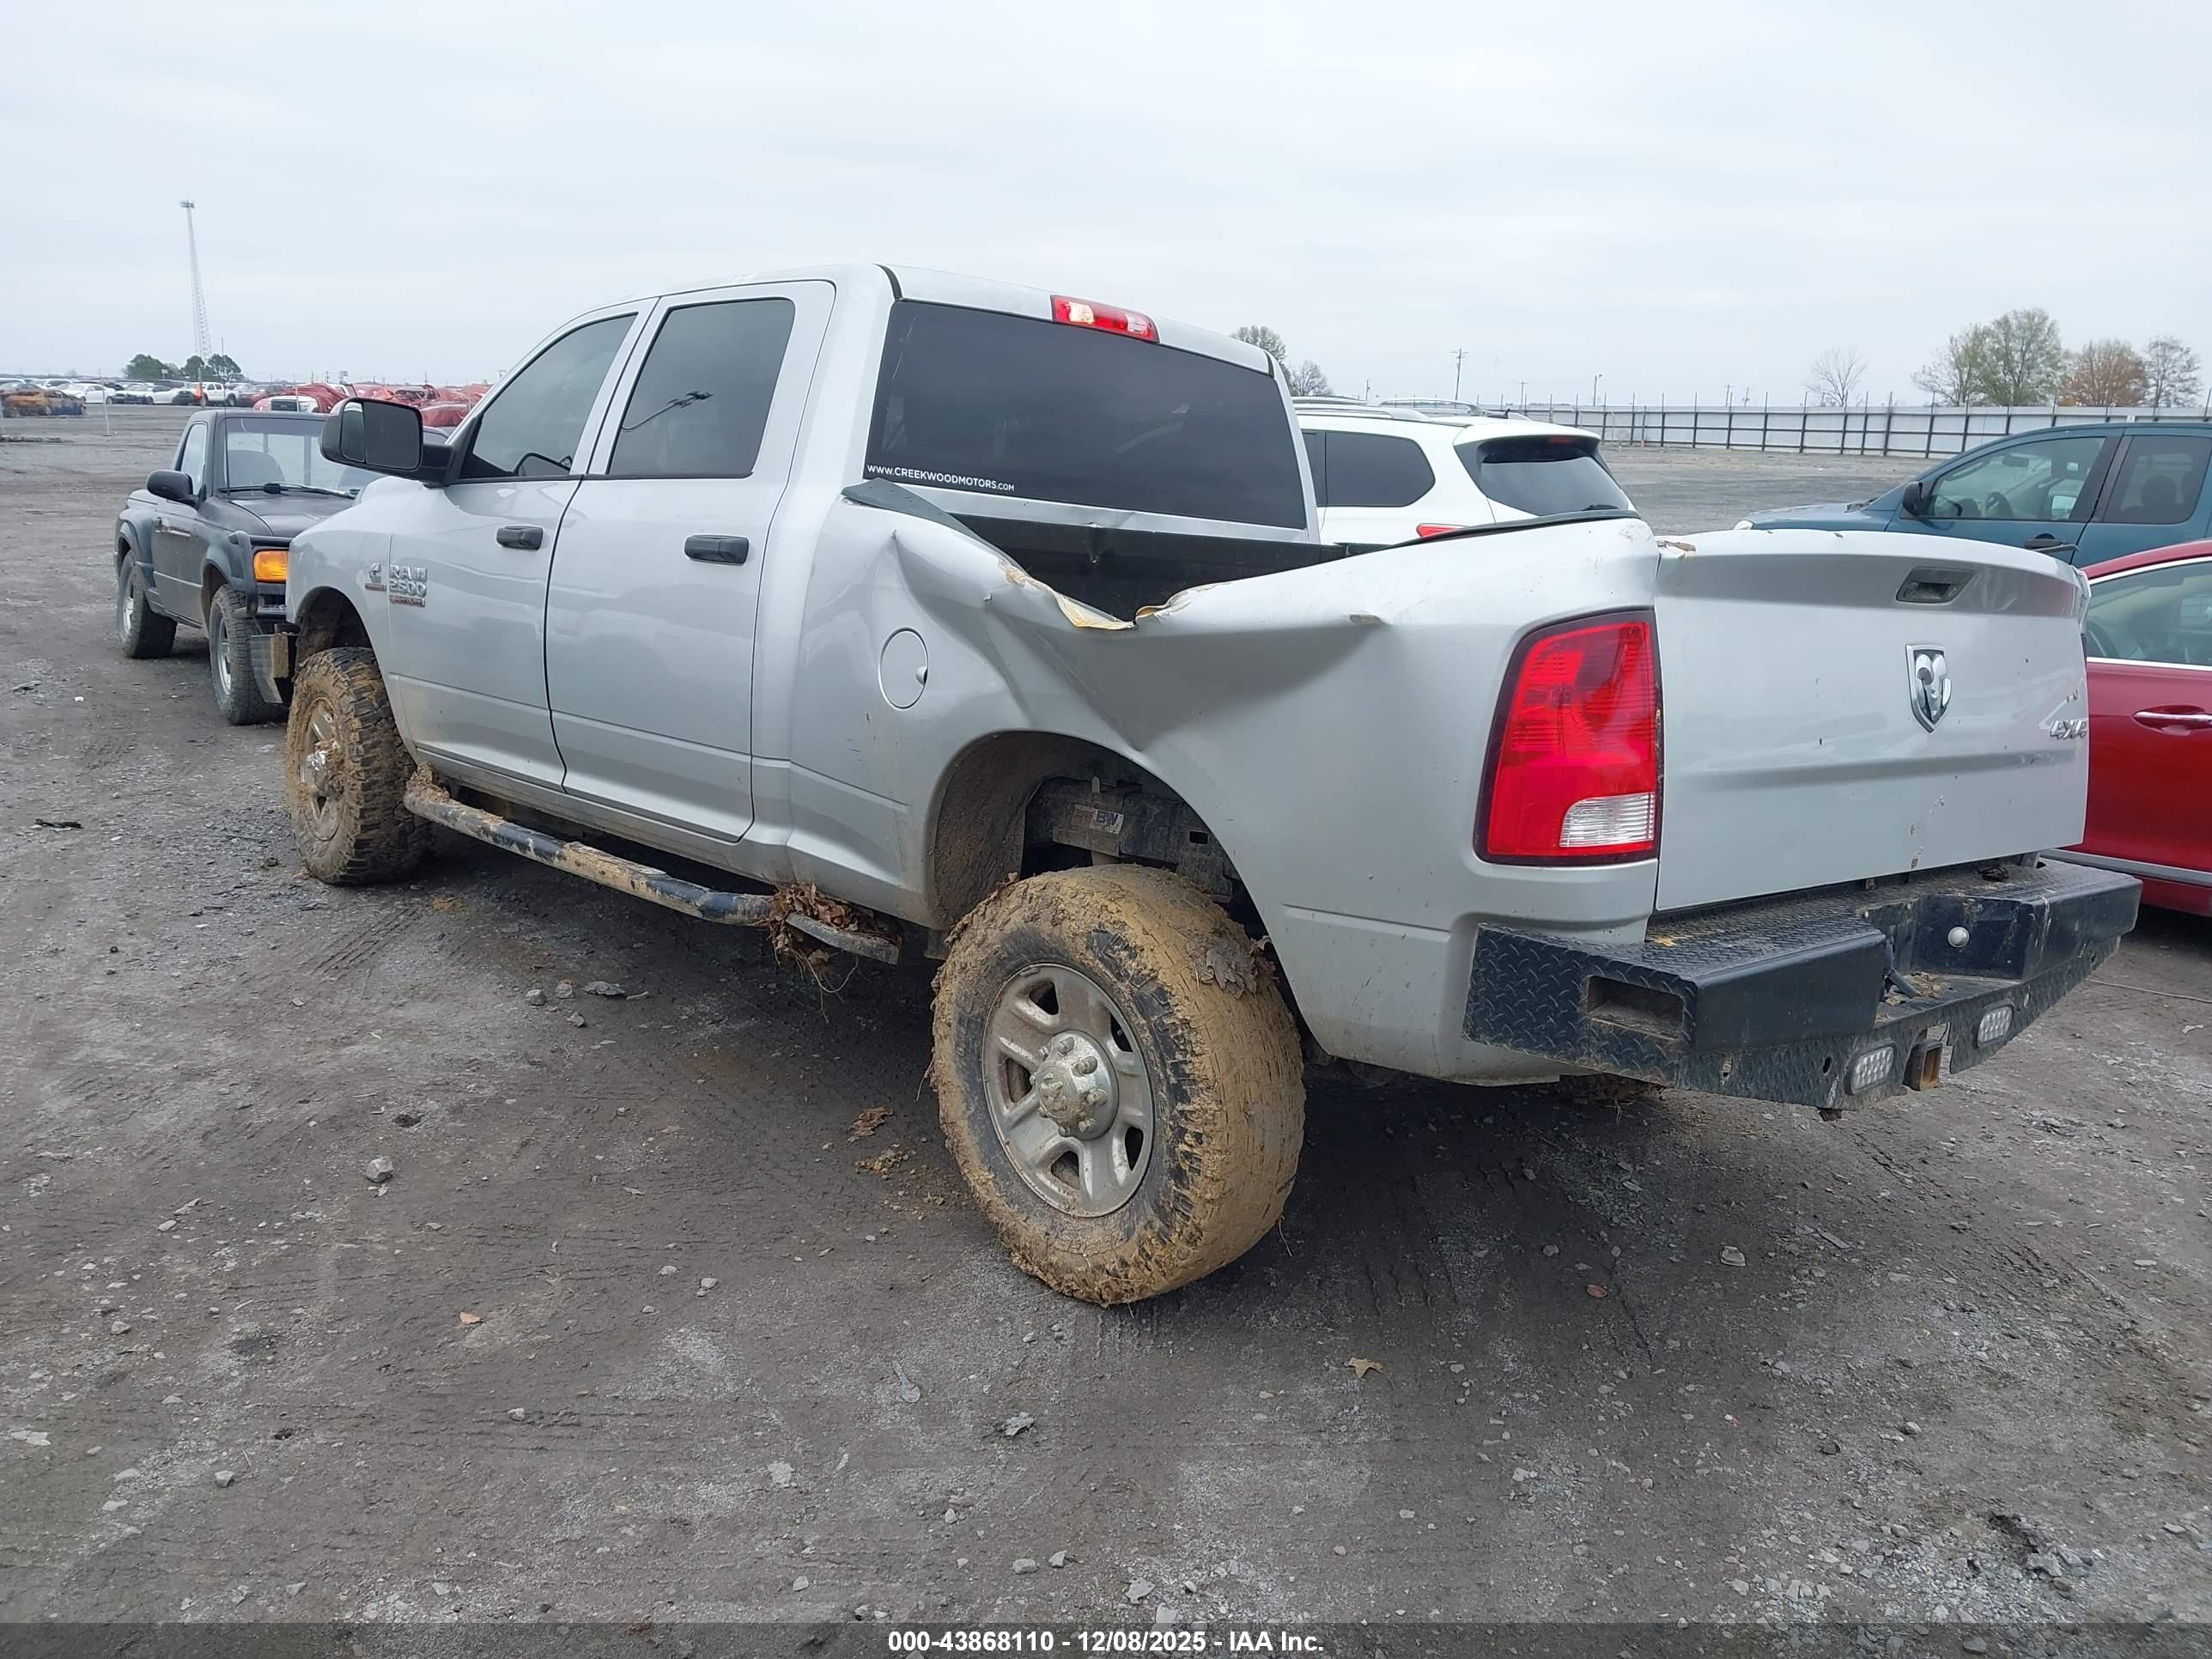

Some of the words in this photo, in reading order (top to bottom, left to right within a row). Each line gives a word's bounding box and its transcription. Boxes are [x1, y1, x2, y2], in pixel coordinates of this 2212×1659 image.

[866, 465, 1015, 491] WWW.CREEKWOODMOTORS.COM
[389, 563, 427, 582] RAM
[388, 579, 427, 597] 2500
